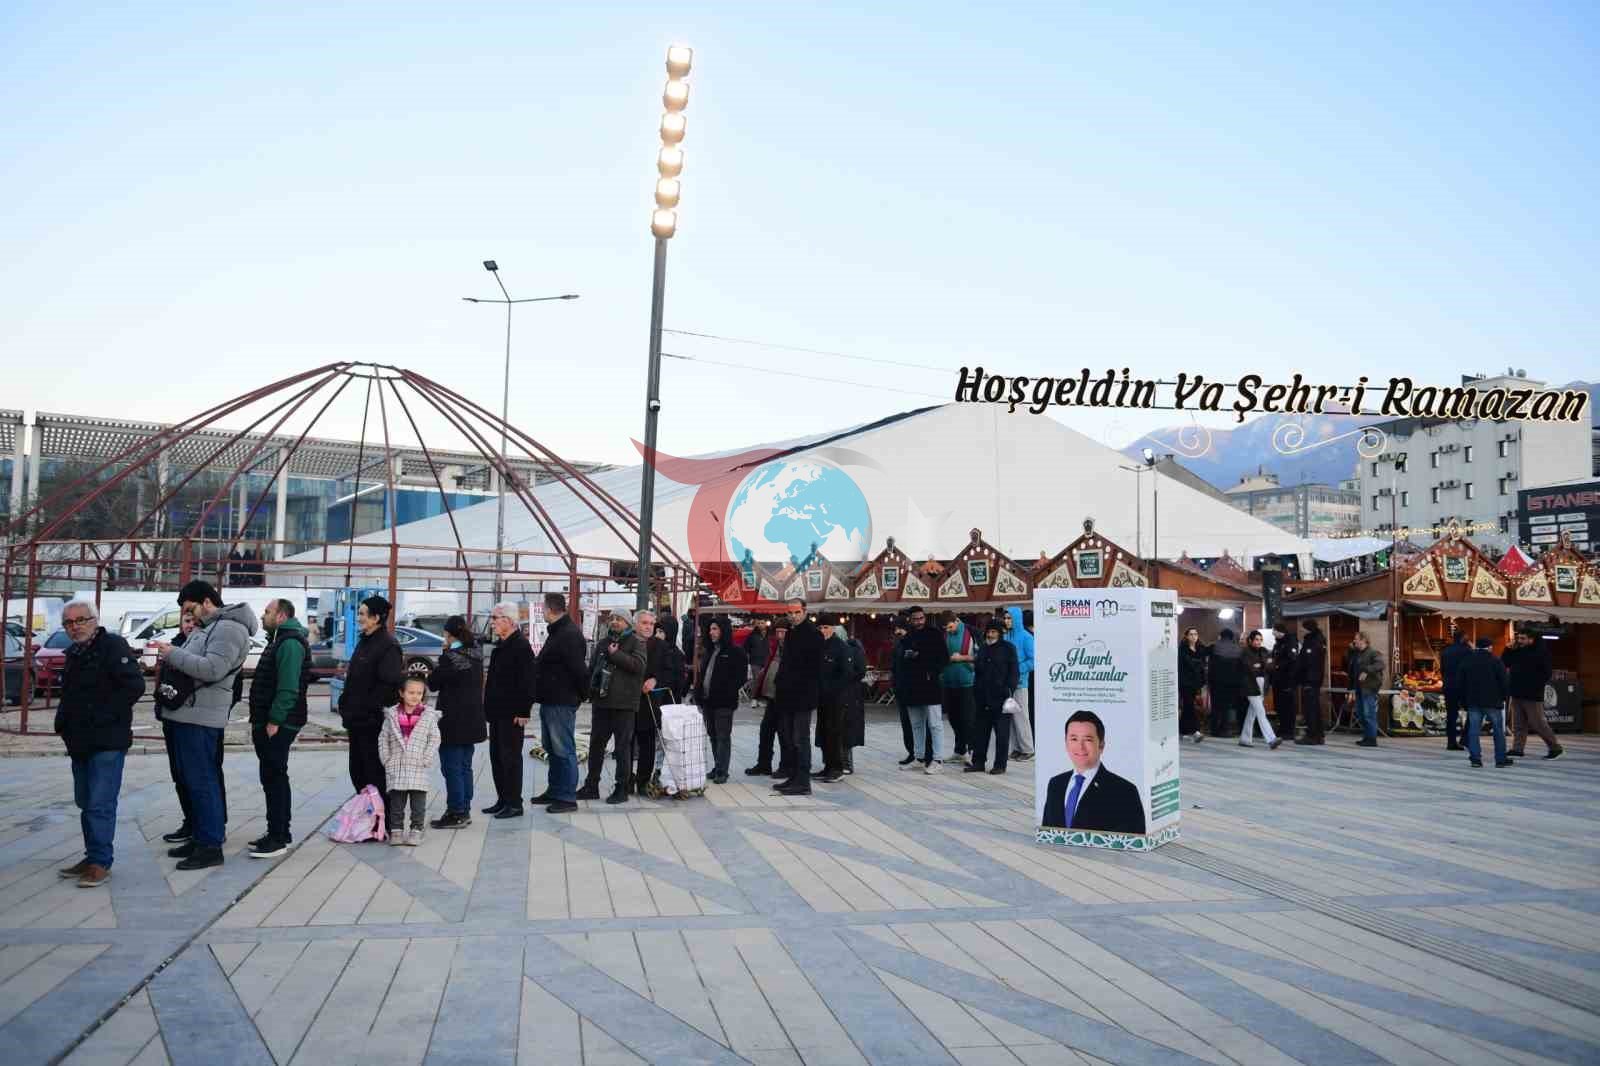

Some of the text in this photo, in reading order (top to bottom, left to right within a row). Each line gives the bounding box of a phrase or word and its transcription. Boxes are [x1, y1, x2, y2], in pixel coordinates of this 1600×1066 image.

[955, 366, 1589, 423] Hoşgeldin Ya Şehr-i Ramazan
[1060, 599, 1090, 608] ERKAN
[1062, 607, 1090, 616] AYDIN
[1066, 647, 1113, 669] Hayırlı
[1049, 662, 1128, 683] Ramazanlar
